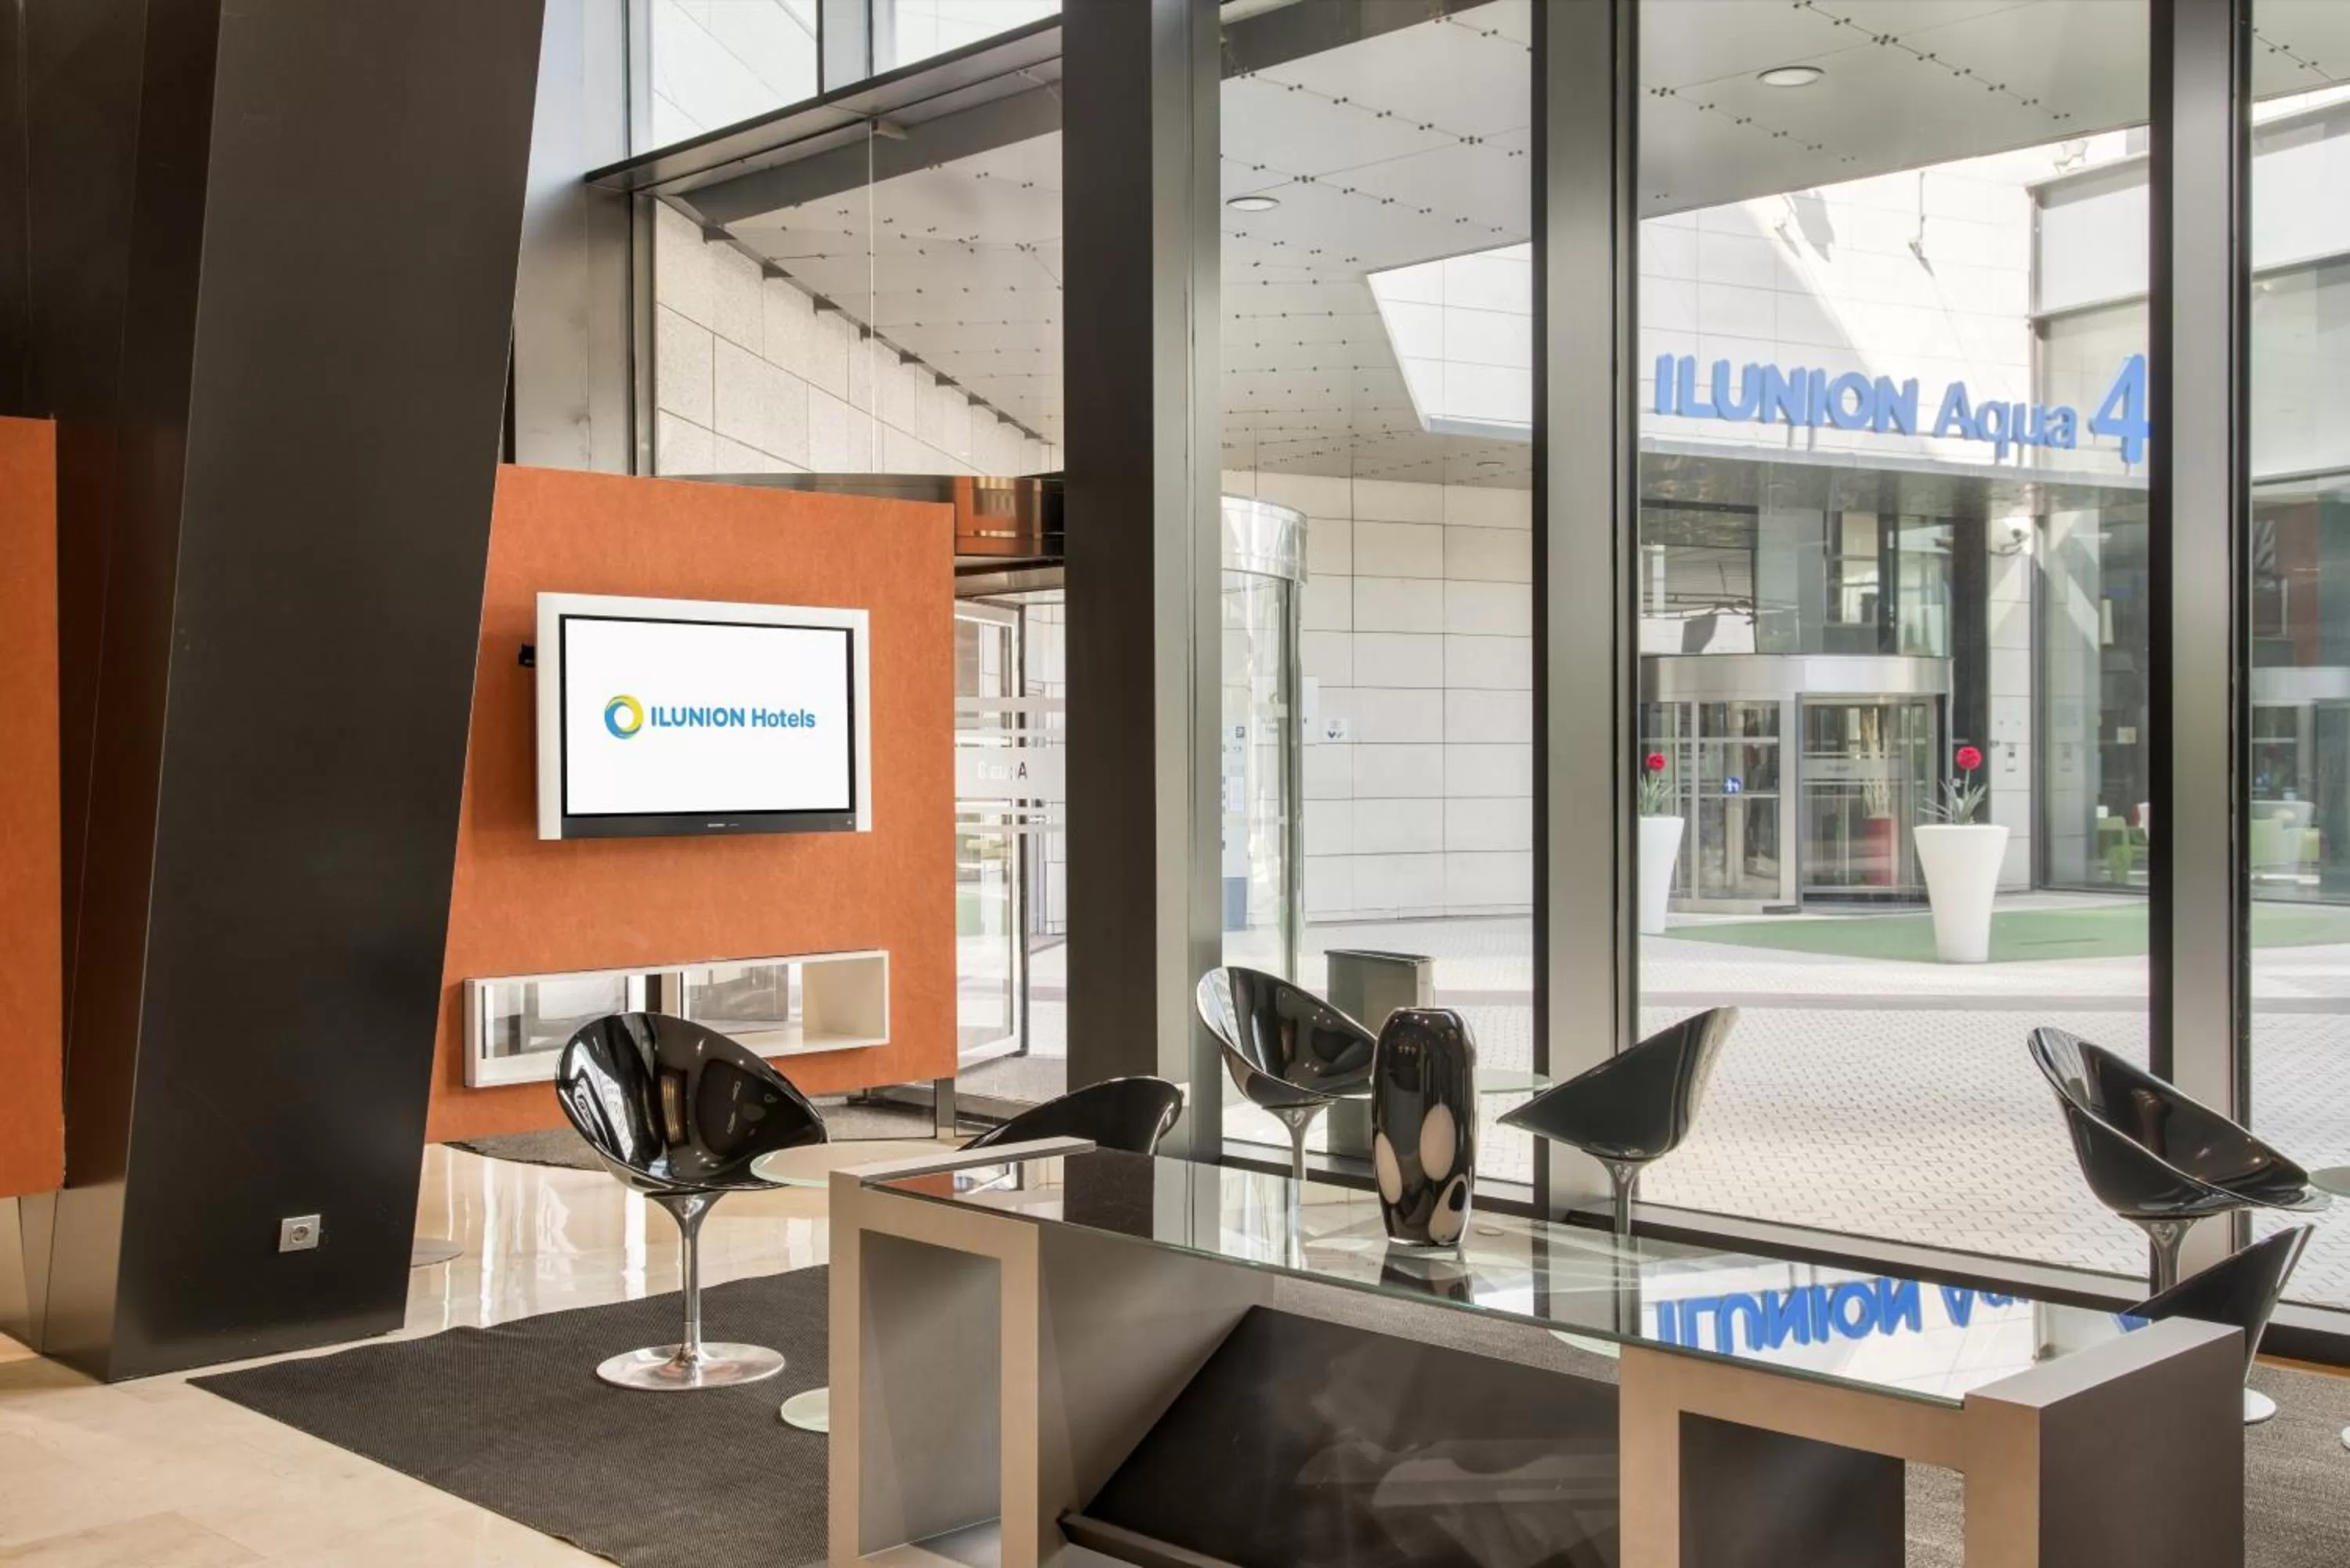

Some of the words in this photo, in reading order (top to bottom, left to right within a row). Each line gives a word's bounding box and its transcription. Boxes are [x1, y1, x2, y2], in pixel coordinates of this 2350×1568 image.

[1654, 352, 1919, 435] ILUNION
[1933, 381, 2078, 458] Aqua
[2088, 353, 2149, 464] 4
[650, 706, 746, 728] ILUNION
[751, 707, 816, 728] Hotels
